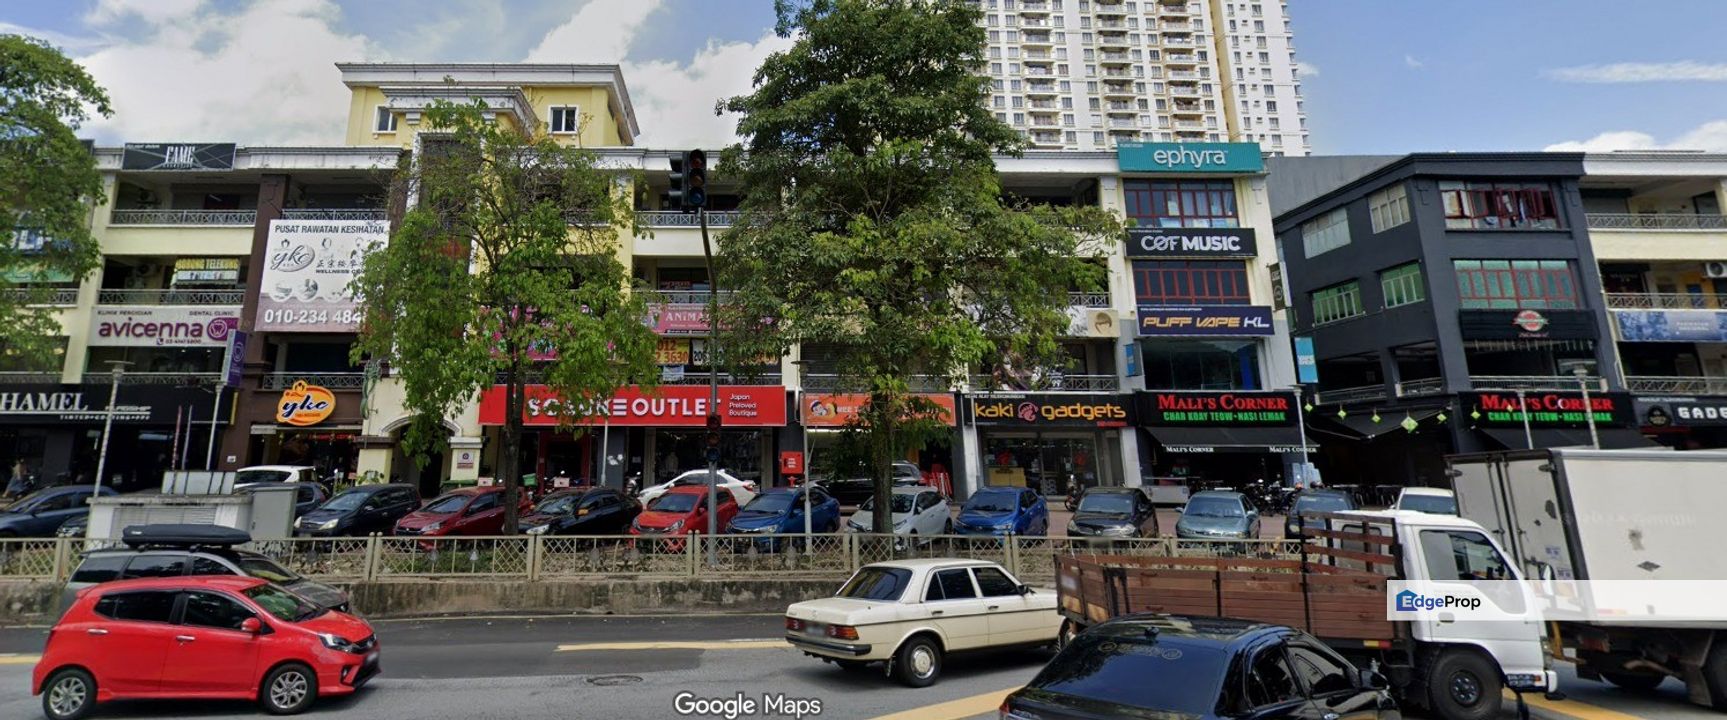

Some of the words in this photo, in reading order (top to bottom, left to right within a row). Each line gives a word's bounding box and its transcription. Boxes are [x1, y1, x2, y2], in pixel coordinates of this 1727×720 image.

[1153, 146, 1226, 168] ephyra
[275, 225, 300, 234] PUSAT
[301, 225, 340, 234] RAWATAN
[341, 225, 385, 234] KESIHATAN
[1181, 235, 1241, 251] MUSIC
[264, 309, 328, 324] 010-234
[1143, 317, 1192, 328] PUFF
[1196, 317, 1241, 328] VAPE
[1243, 317, 1270, 328] KL
[98, 317, 204, 338] avicenna
[729, 394, 750, 402] Japan
[1158, 394, 1216, 409] MALI'S
[1220, 394, 1288, 410] CORNER
[975, 402, 1014, 417] kaki
[1041, 402, 1127, 420] gadgets
[1164, 412, 1186, 421] CHAR
[1210, 412, 1233, 421] TEOW
[1238, 412, 1257, 421] NASI
[1259, 412, 1285, 421] LEMAK
[1488, 412, 1511, 421] CHAR
